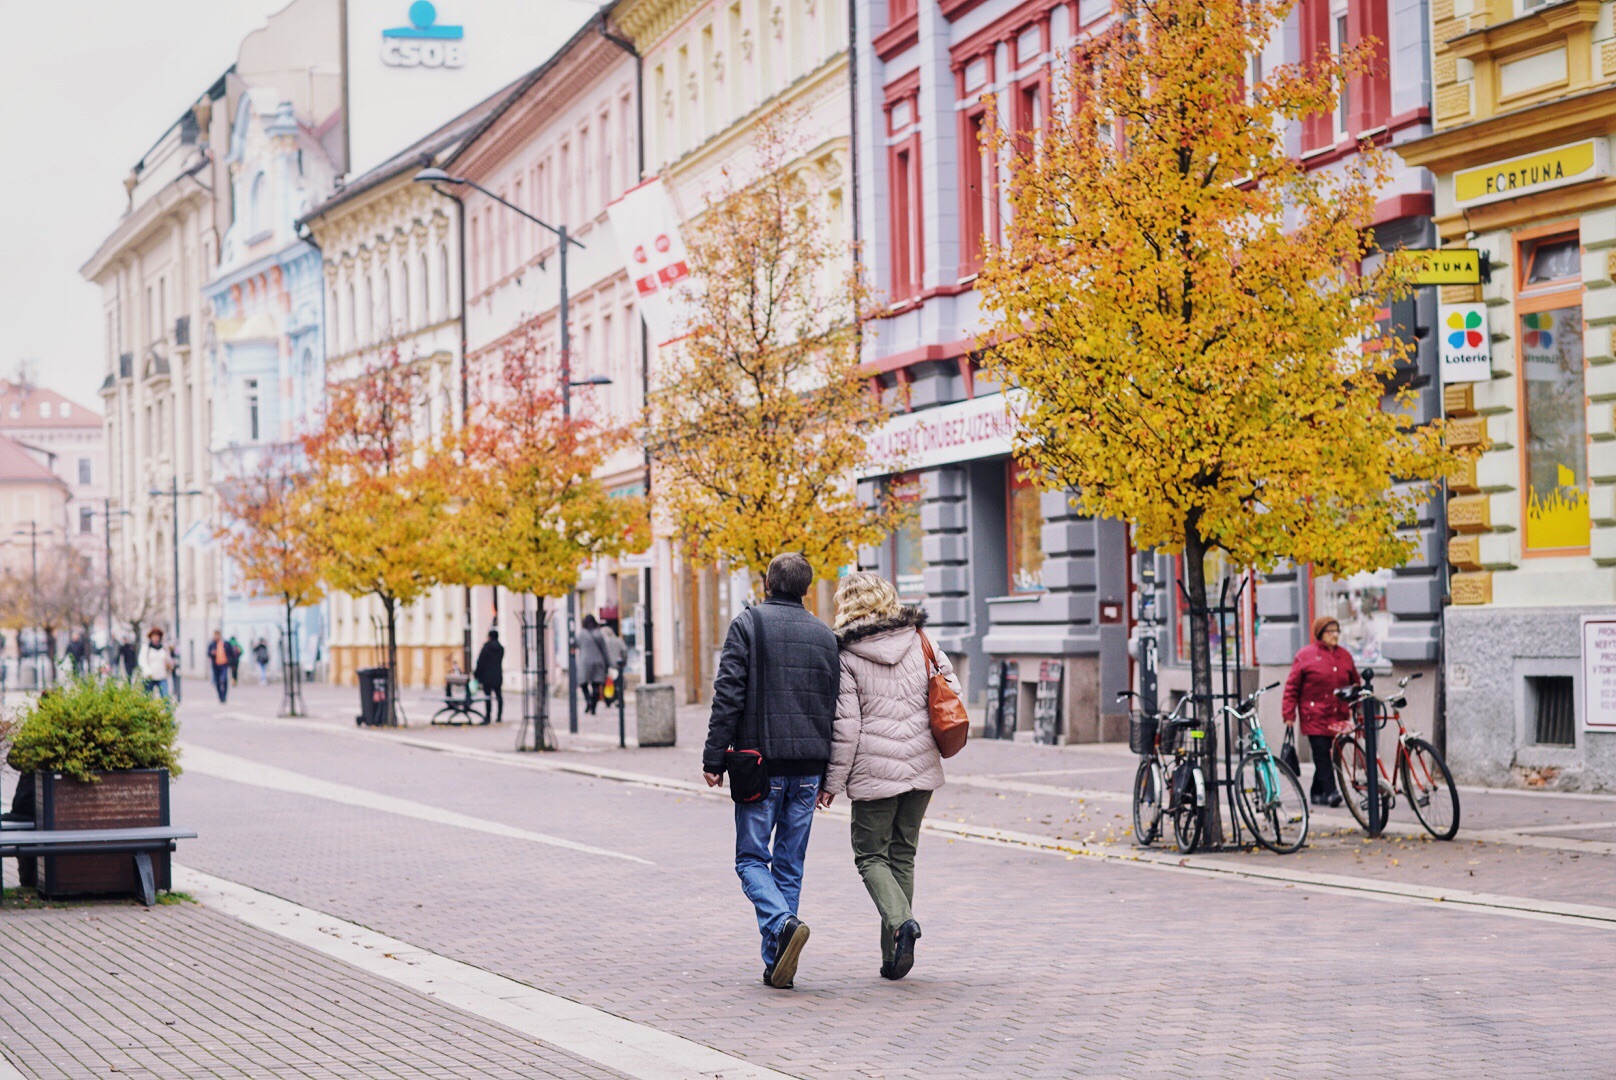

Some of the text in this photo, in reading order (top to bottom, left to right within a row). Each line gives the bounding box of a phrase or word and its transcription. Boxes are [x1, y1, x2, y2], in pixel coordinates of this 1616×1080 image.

[1485, 160, 1565, 194] FORTUNA
[1406, 262, 1473, 272] RTUNA
[1445, 354, 1488, 364] Loterie
